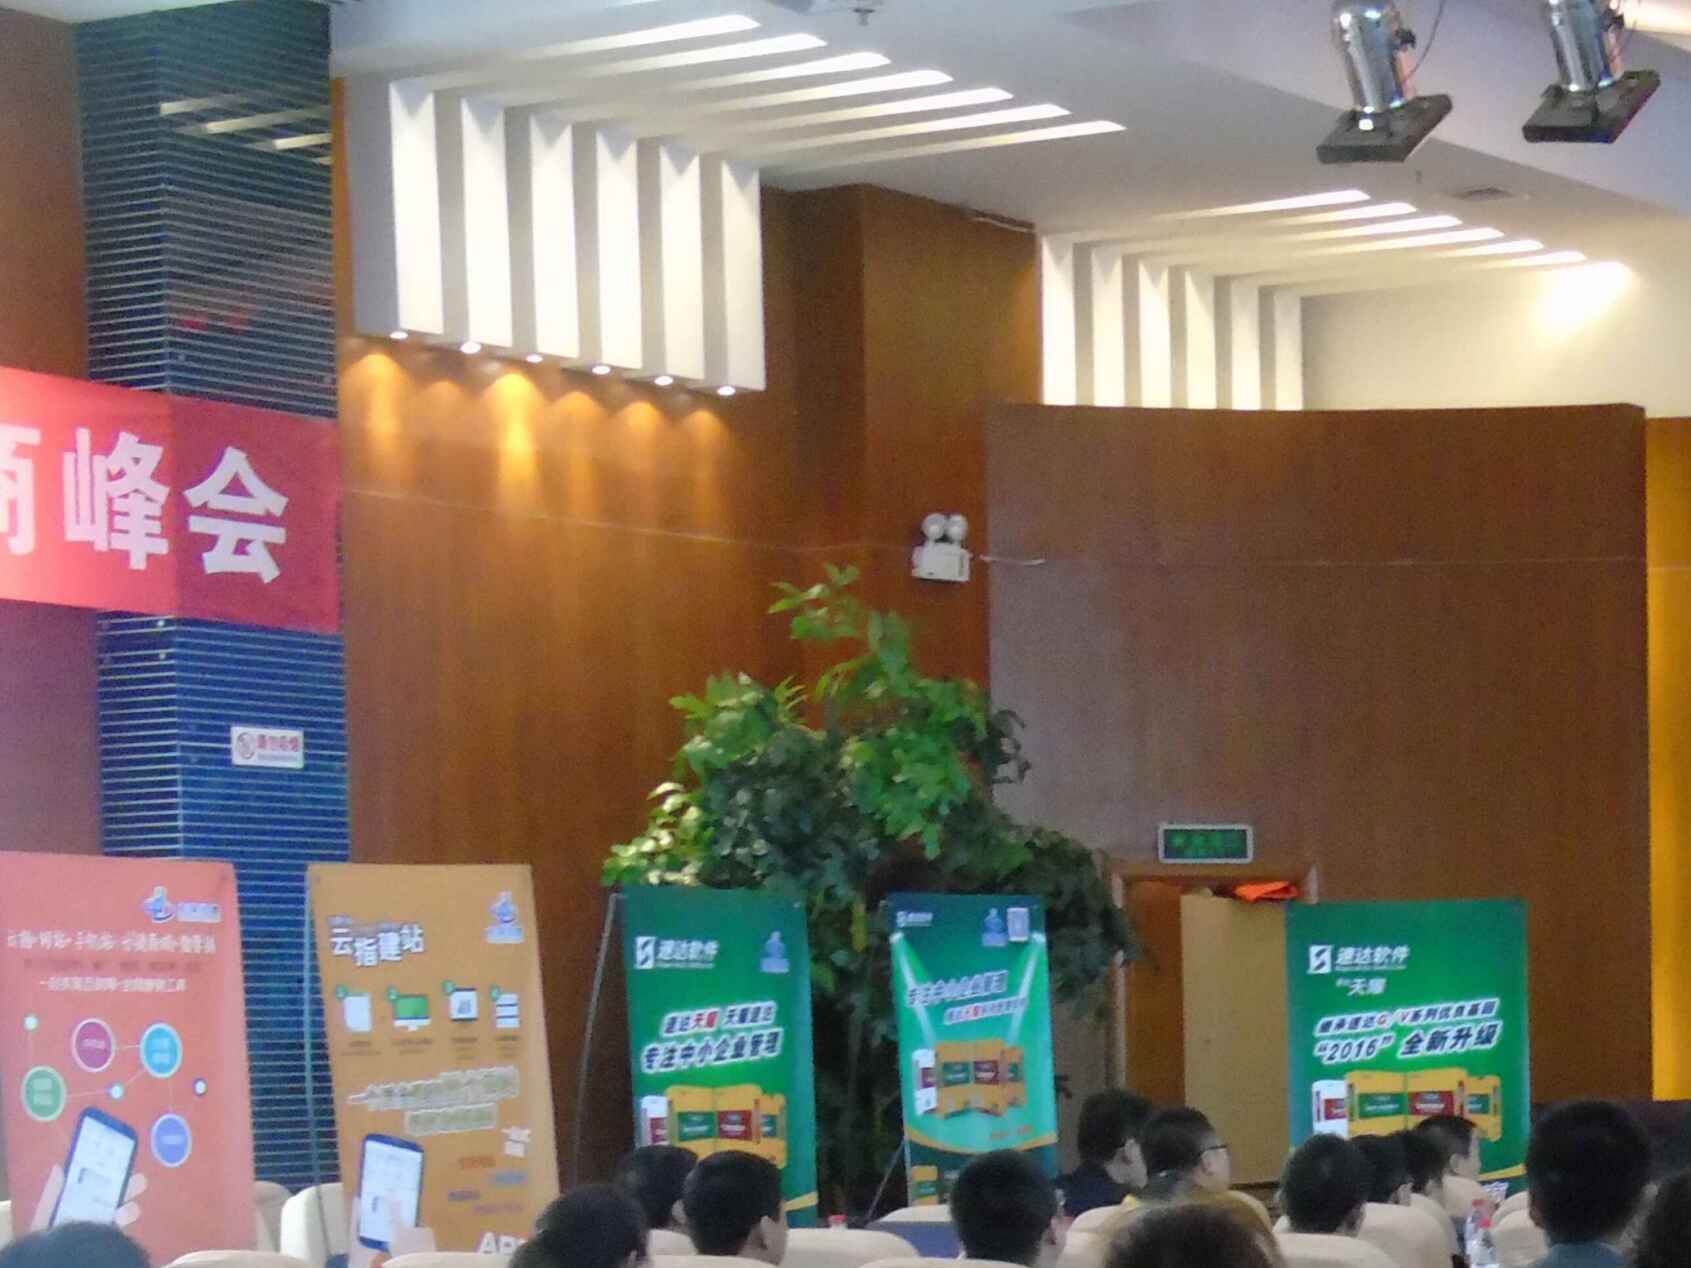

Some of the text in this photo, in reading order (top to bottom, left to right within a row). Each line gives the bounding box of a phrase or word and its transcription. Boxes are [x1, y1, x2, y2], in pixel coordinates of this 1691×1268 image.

[329, 922, 425, 968] 云指建站
[1336, 945, 1410, 965] 速达软件
[643, 1030, 781, 1071] 专注中小企业管理
[1400, 1023, 1500, 1057] 全新升级
